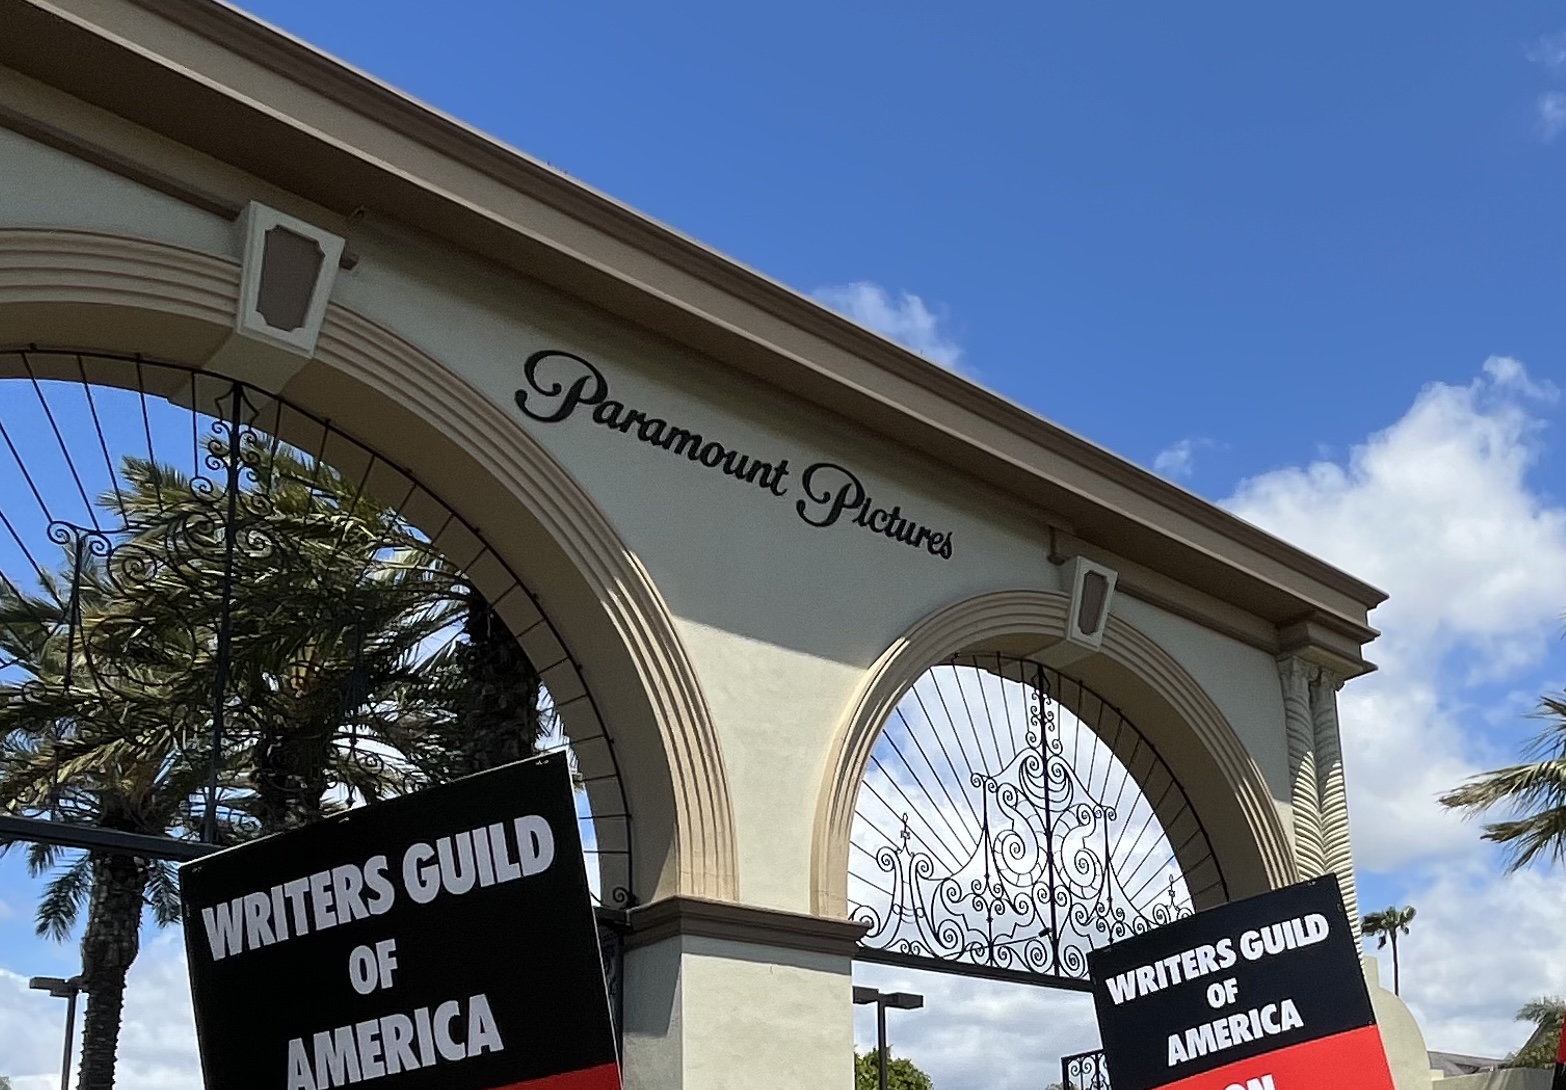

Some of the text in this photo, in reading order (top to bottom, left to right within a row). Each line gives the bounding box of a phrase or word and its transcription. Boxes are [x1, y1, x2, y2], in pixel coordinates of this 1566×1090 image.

[514, 350, 954, 560] Paramount Pictures
[201, 814, 555, 962] WRITERS GUILD
[349, 939, 398, 996] OF
[1105, 913, 1330, 1005] WRITERS GUILD
[1207, 978, 1239, 1009] OF
[1167, 999, 1304, 1067] AMERICA
